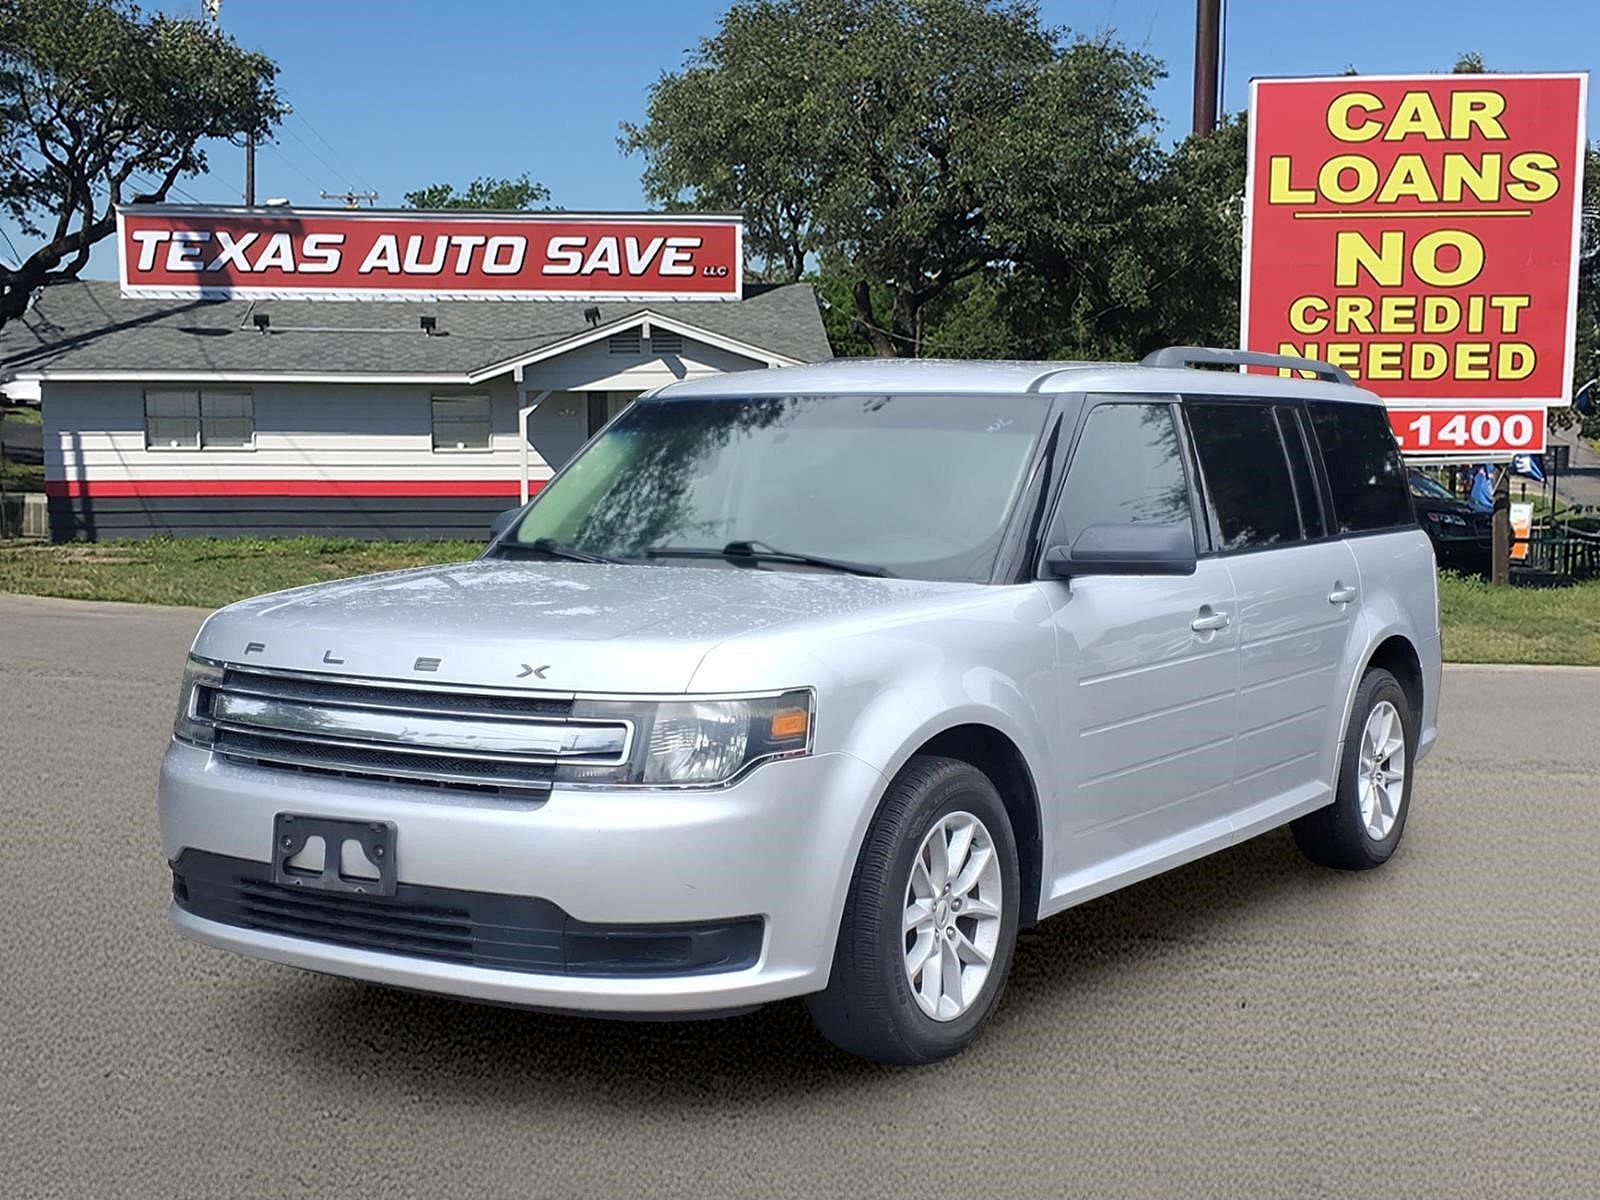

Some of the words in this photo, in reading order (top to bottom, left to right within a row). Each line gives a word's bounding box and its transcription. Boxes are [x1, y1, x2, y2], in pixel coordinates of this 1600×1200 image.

[1326, 91, 1507, 142] CAR
[1269, 153, 1560, 204] LOANS
[132, 229, 346, 274] TEXAS
[358, 234, 529, 275] AUTO
[541, 236, 703, 277] SAVE
[703, 265, 728, 277] LLC
[1335, 229, 1485, 287] NO
[1289, 295, 1530, 334] CREDIT
[1277, 342, 1537, 380] NEEDED
[1389, 413, 1534, 447] .1400
[243, 641, 552, 679] FLEX
